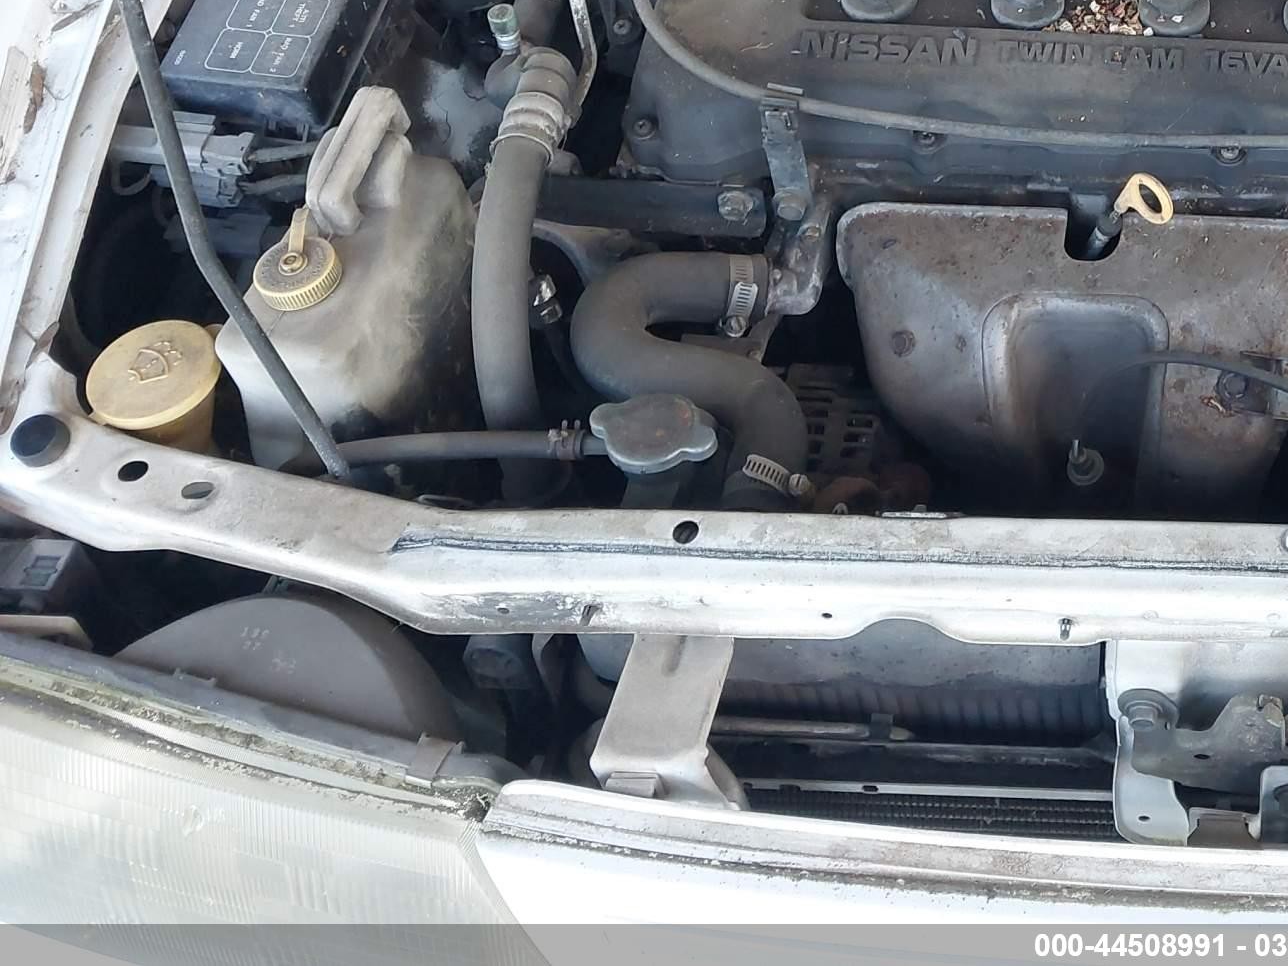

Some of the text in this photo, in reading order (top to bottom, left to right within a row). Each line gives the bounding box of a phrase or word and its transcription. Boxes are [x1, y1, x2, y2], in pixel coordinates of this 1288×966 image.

[800, 30, 978, 66] NISSAN
[998, 39, 1094, 66] TWIN
[1104, 44, 1185, 72] CAM
